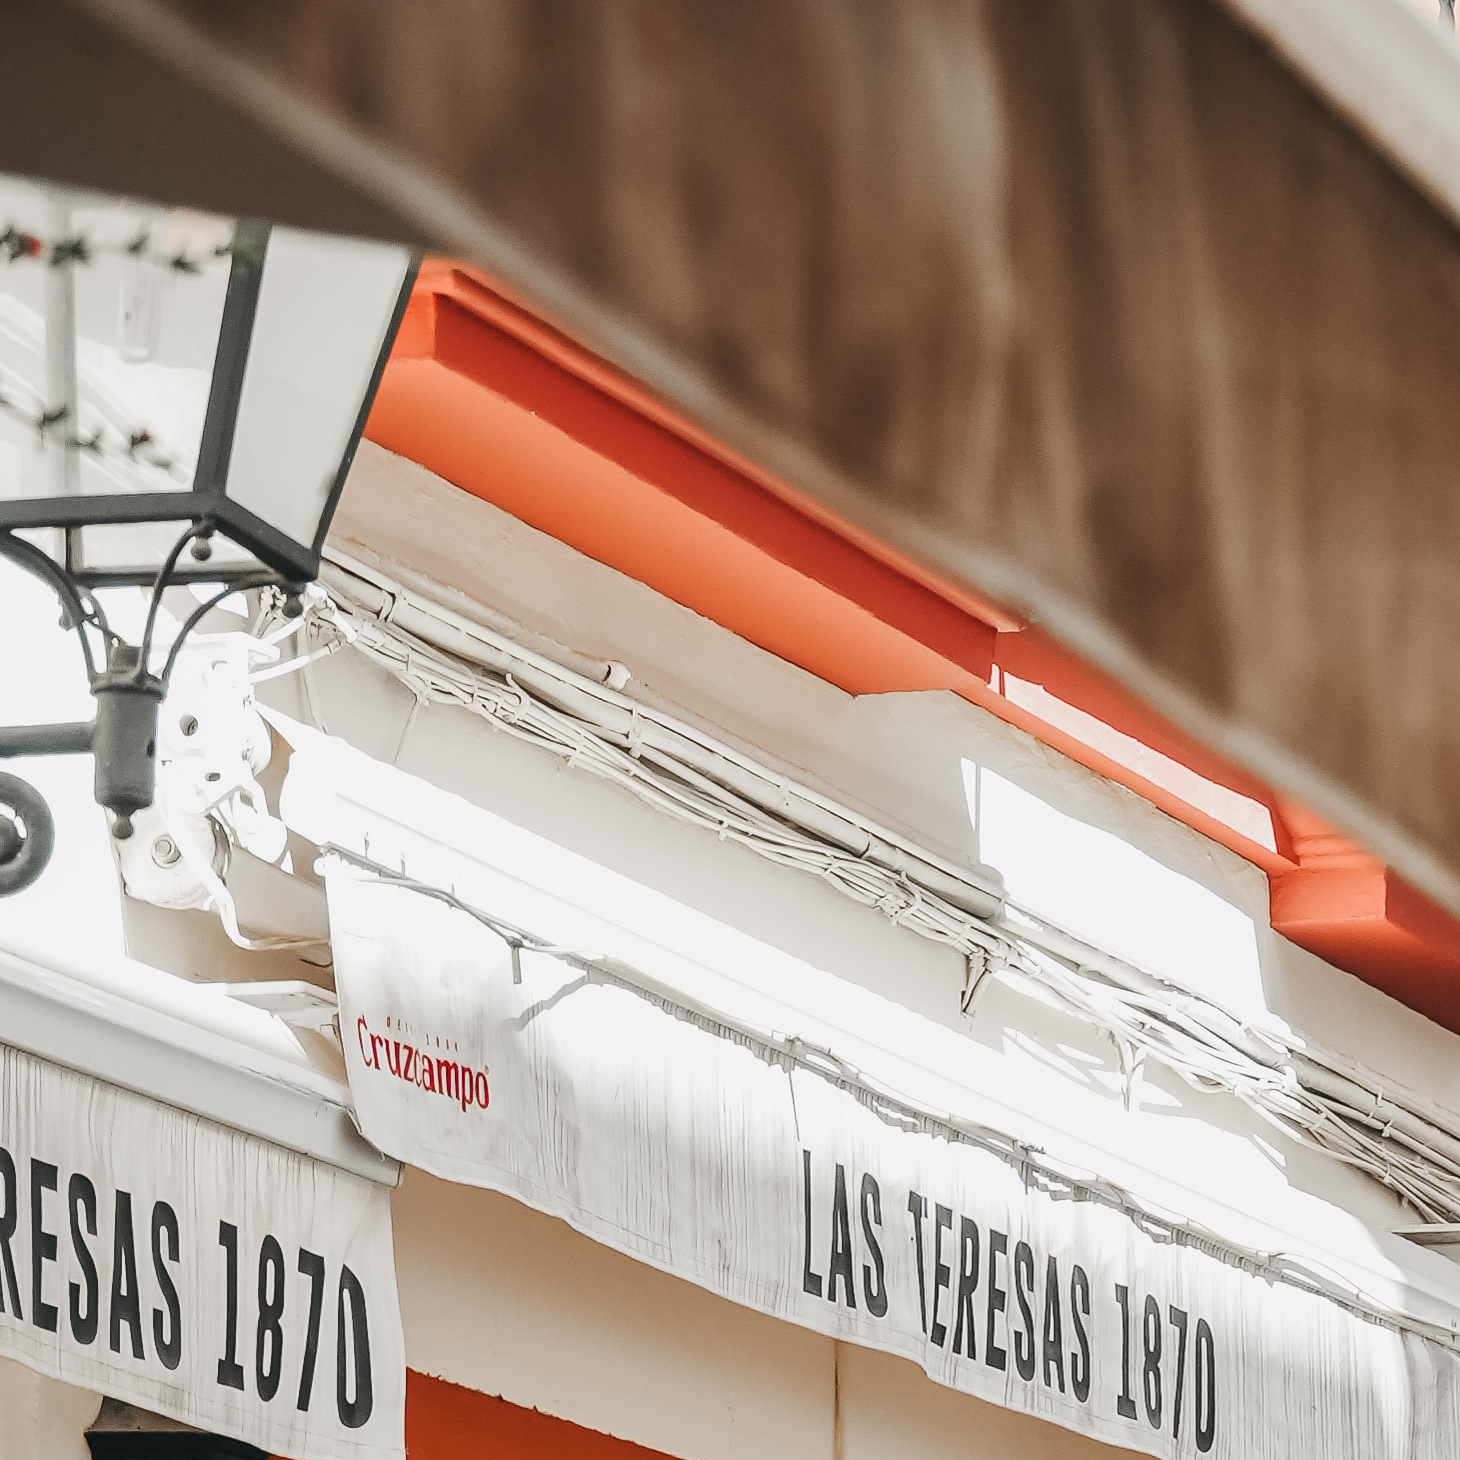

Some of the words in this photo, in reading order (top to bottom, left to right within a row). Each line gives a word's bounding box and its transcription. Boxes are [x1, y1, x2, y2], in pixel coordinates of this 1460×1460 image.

[357, 1014, 490, 1113] Cruzcampo
[216, 1218, 373, 1429] 1870
[802, 1149, 889, 1318] LAS
[907, 1190, 1091, 1403] TERESAS
[1115, 1282, 1216, 1453] 1870
